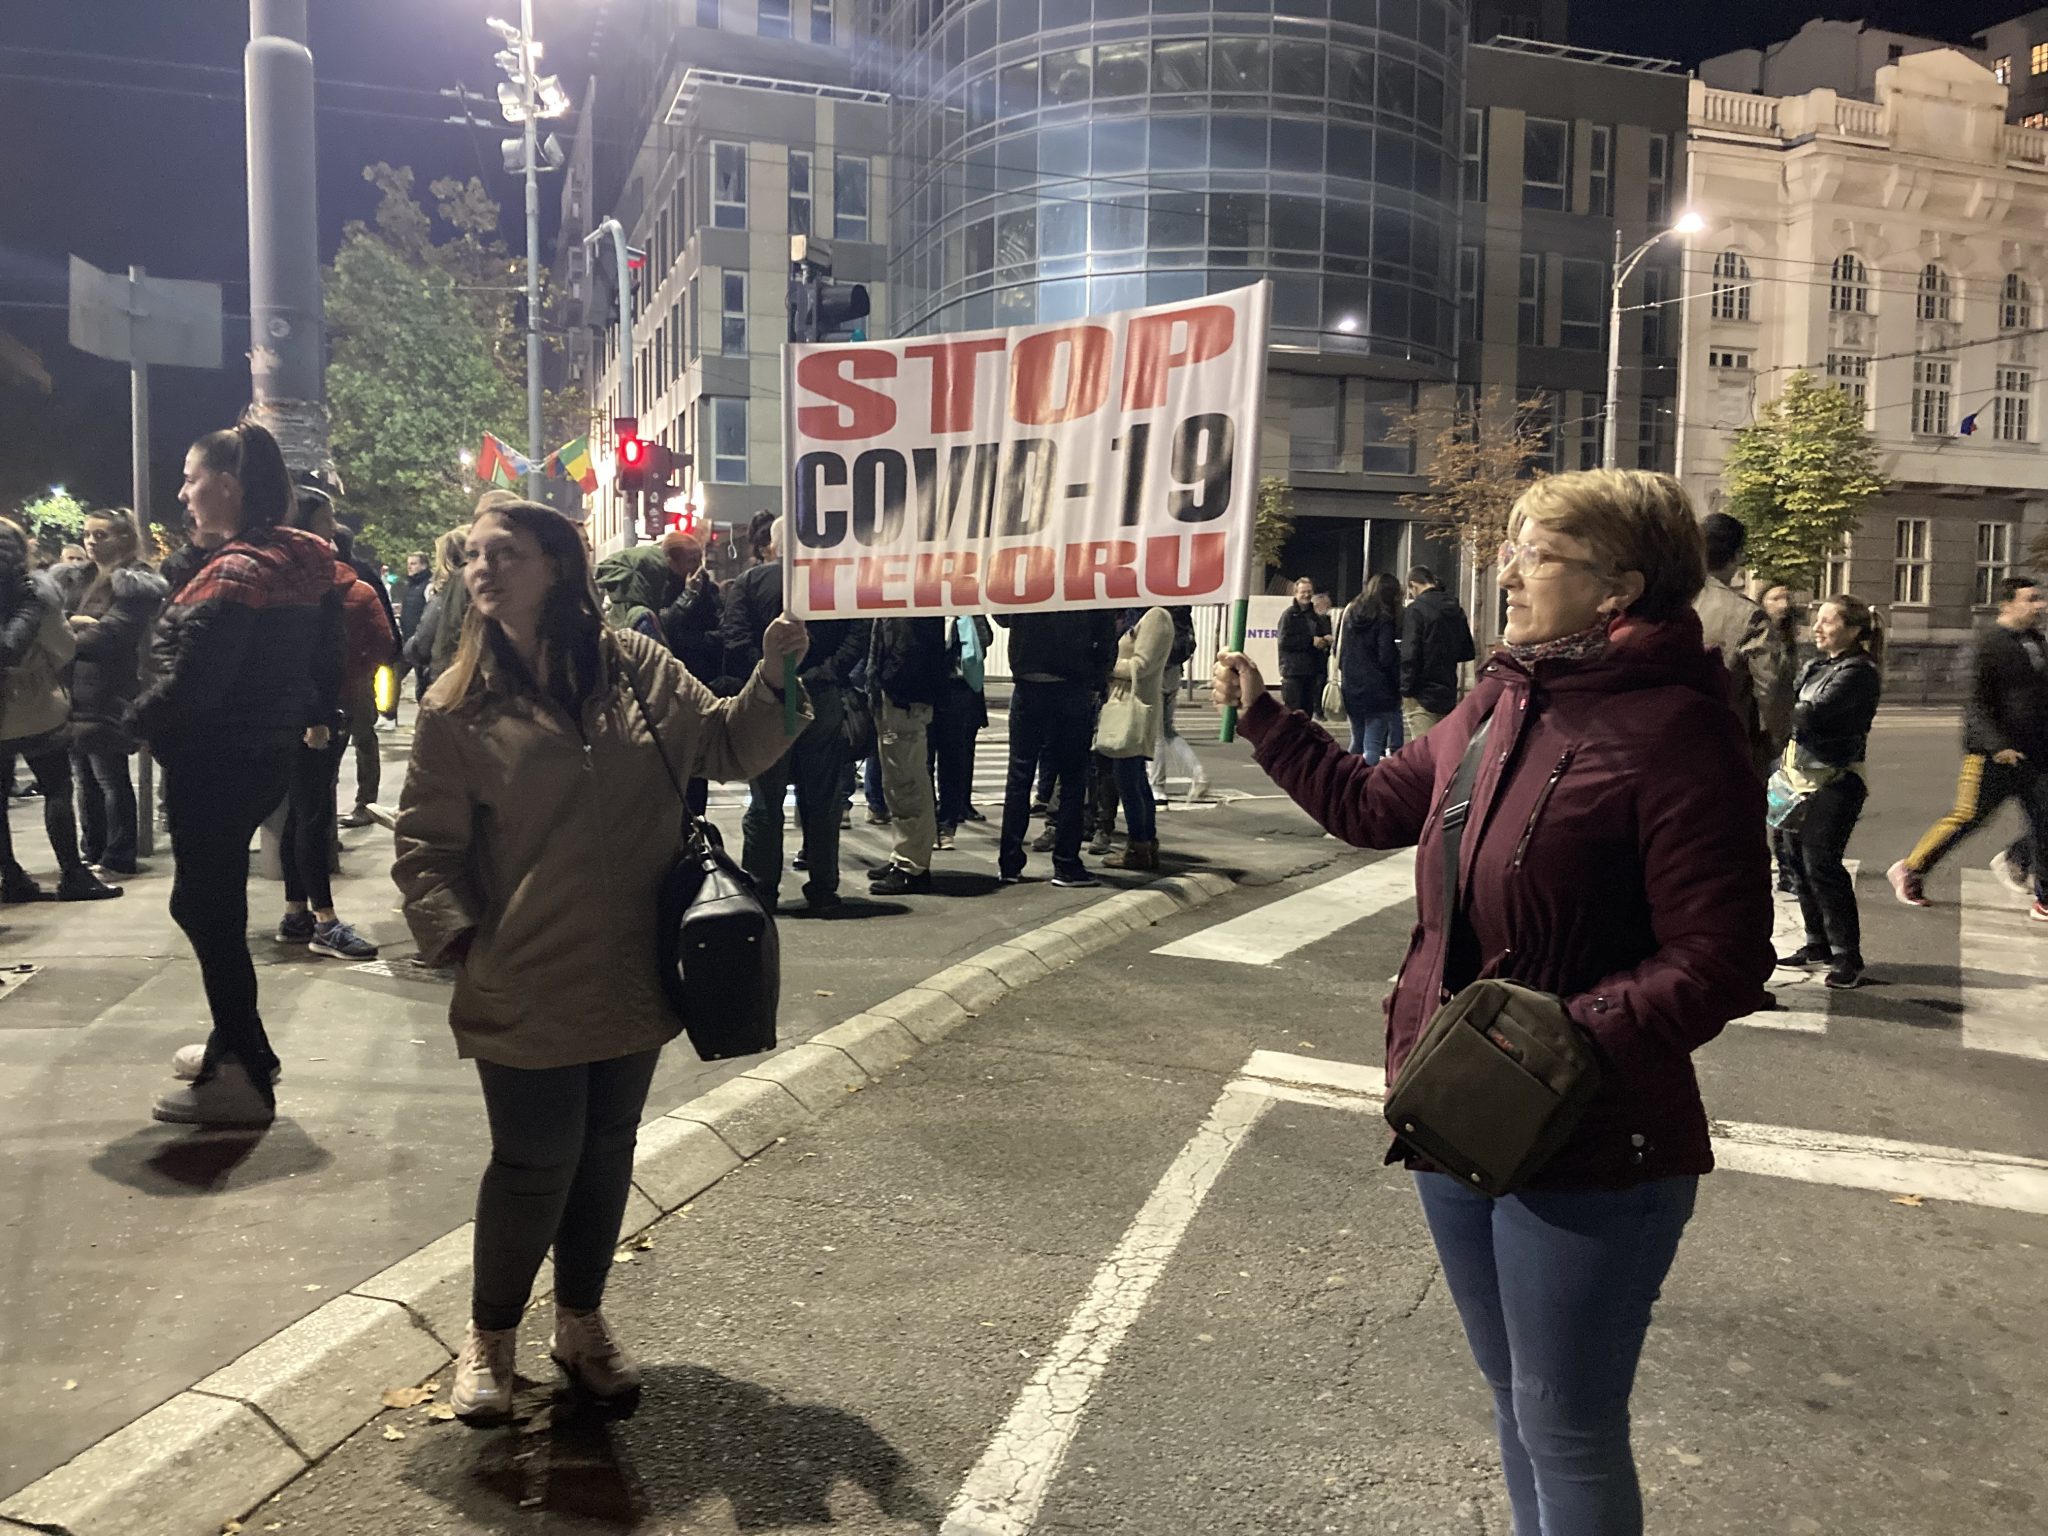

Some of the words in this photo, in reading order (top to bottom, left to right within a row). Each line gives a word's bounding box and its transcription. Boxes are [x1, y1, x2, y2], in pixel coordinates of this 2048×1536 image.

[796, 304, 1236, 441] STOP
[795, 412, 1235, 550] COVID-19
[793, 531, 1227, 612] TERORU
